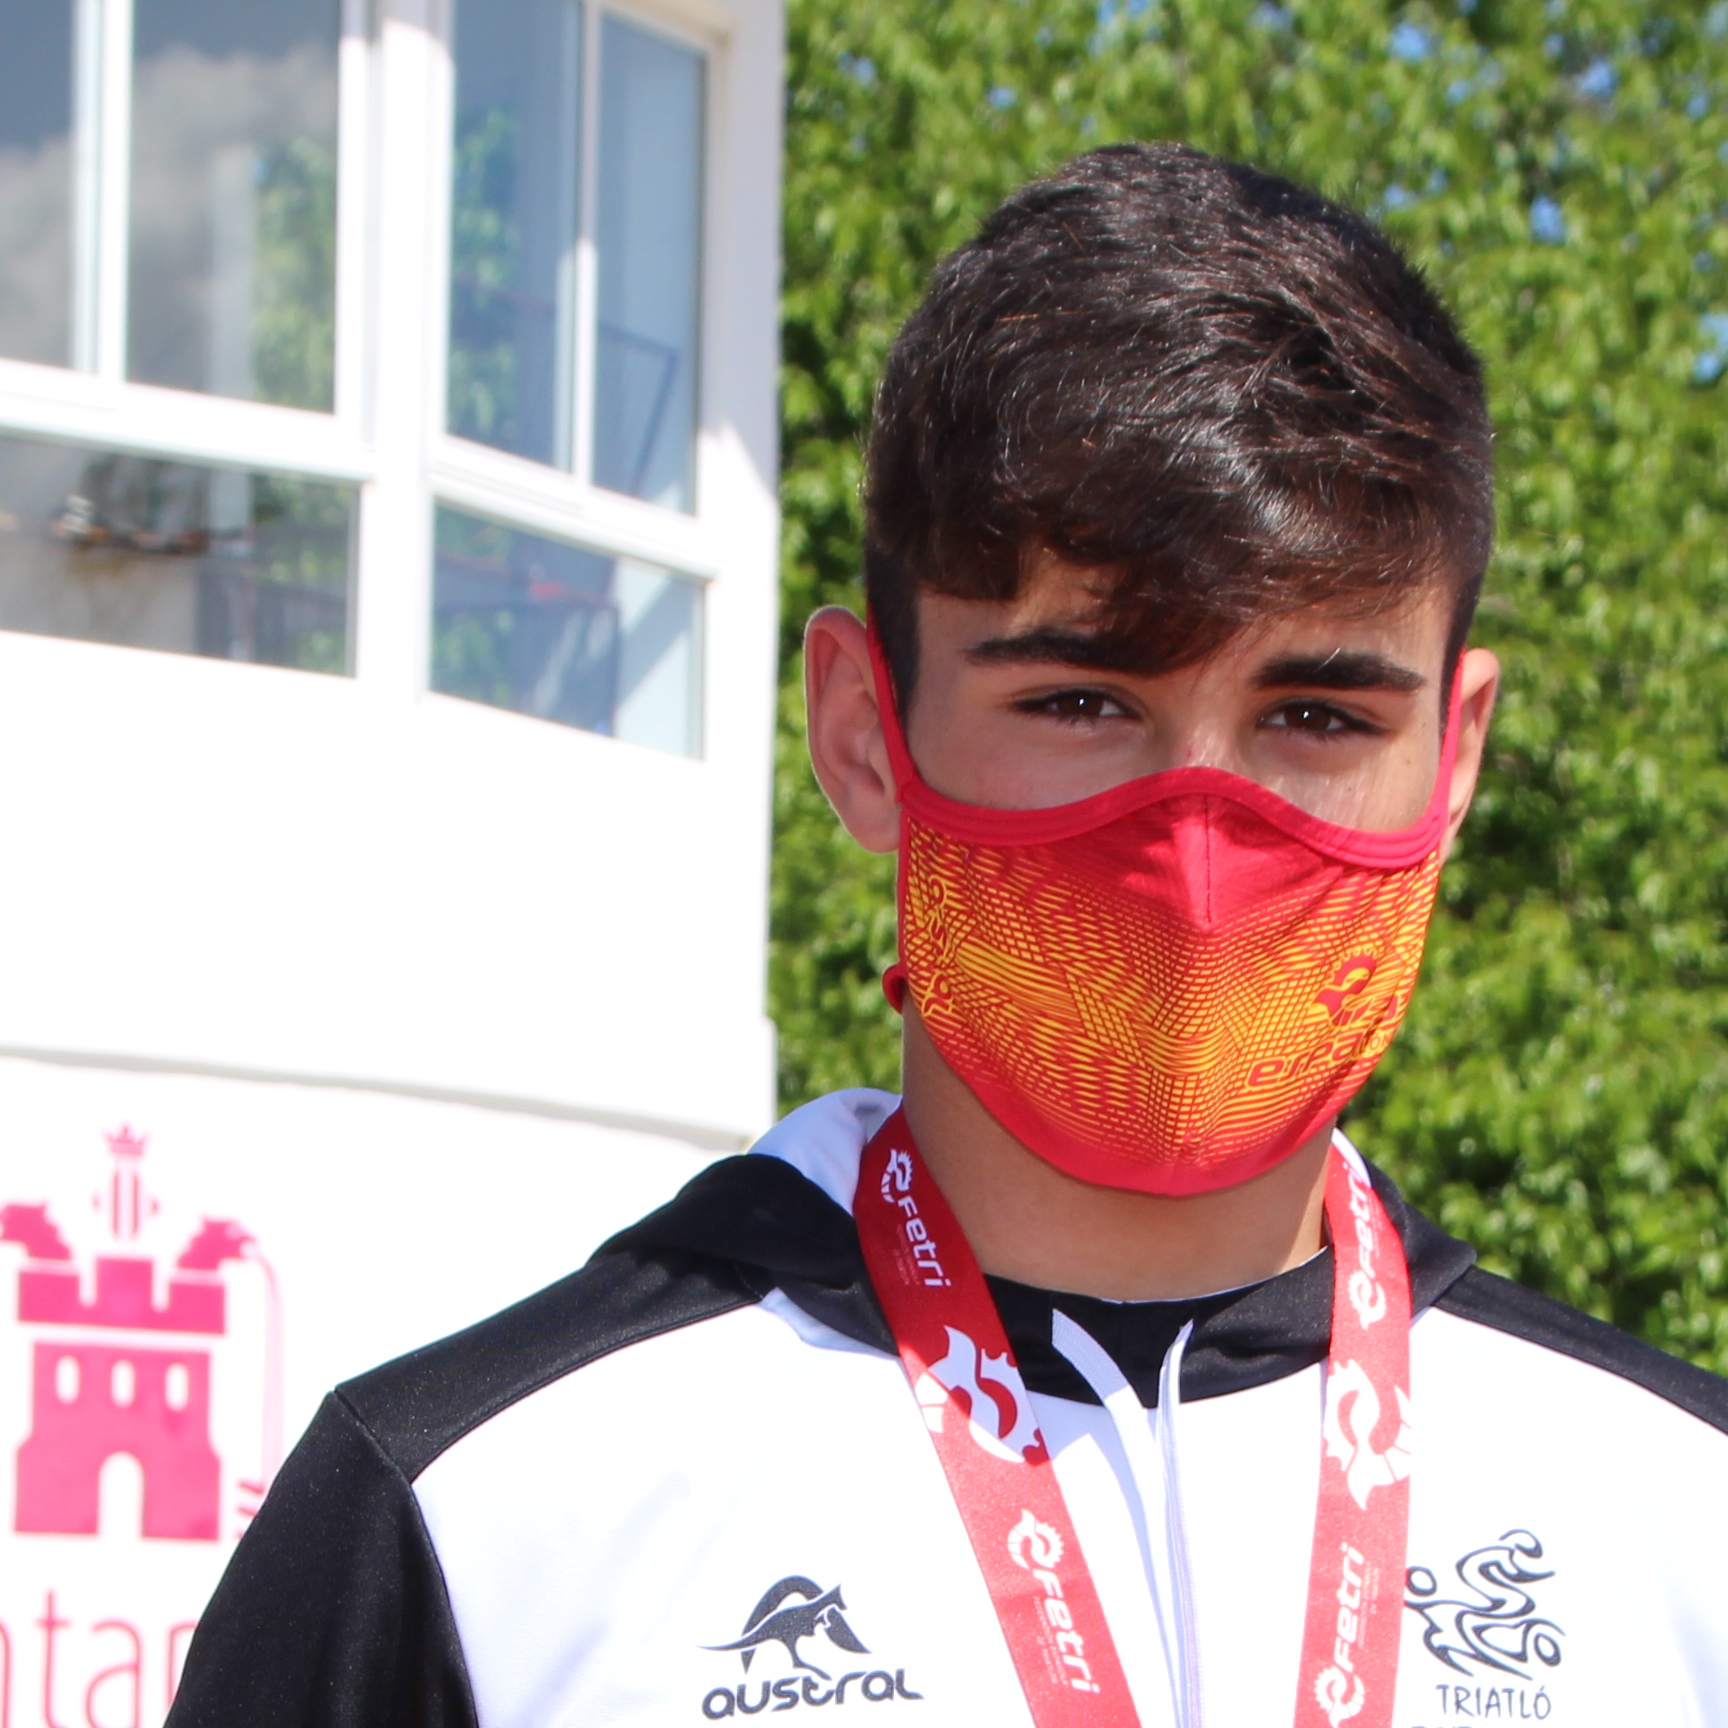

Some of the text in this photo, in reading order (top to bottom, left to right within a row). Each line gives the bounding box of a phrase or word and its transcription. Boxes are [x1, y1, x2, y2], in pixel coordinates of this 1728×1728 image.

[897, 1195, 952, 1287] Fetri
[1032, 1567, 1101, 1694] Fetri
[1334, 1541, 1365, 1673] Fetri
[701, 1668, 924, 1721] austral
[1435, 1685, 1552, 1721] TRIATLÓ
